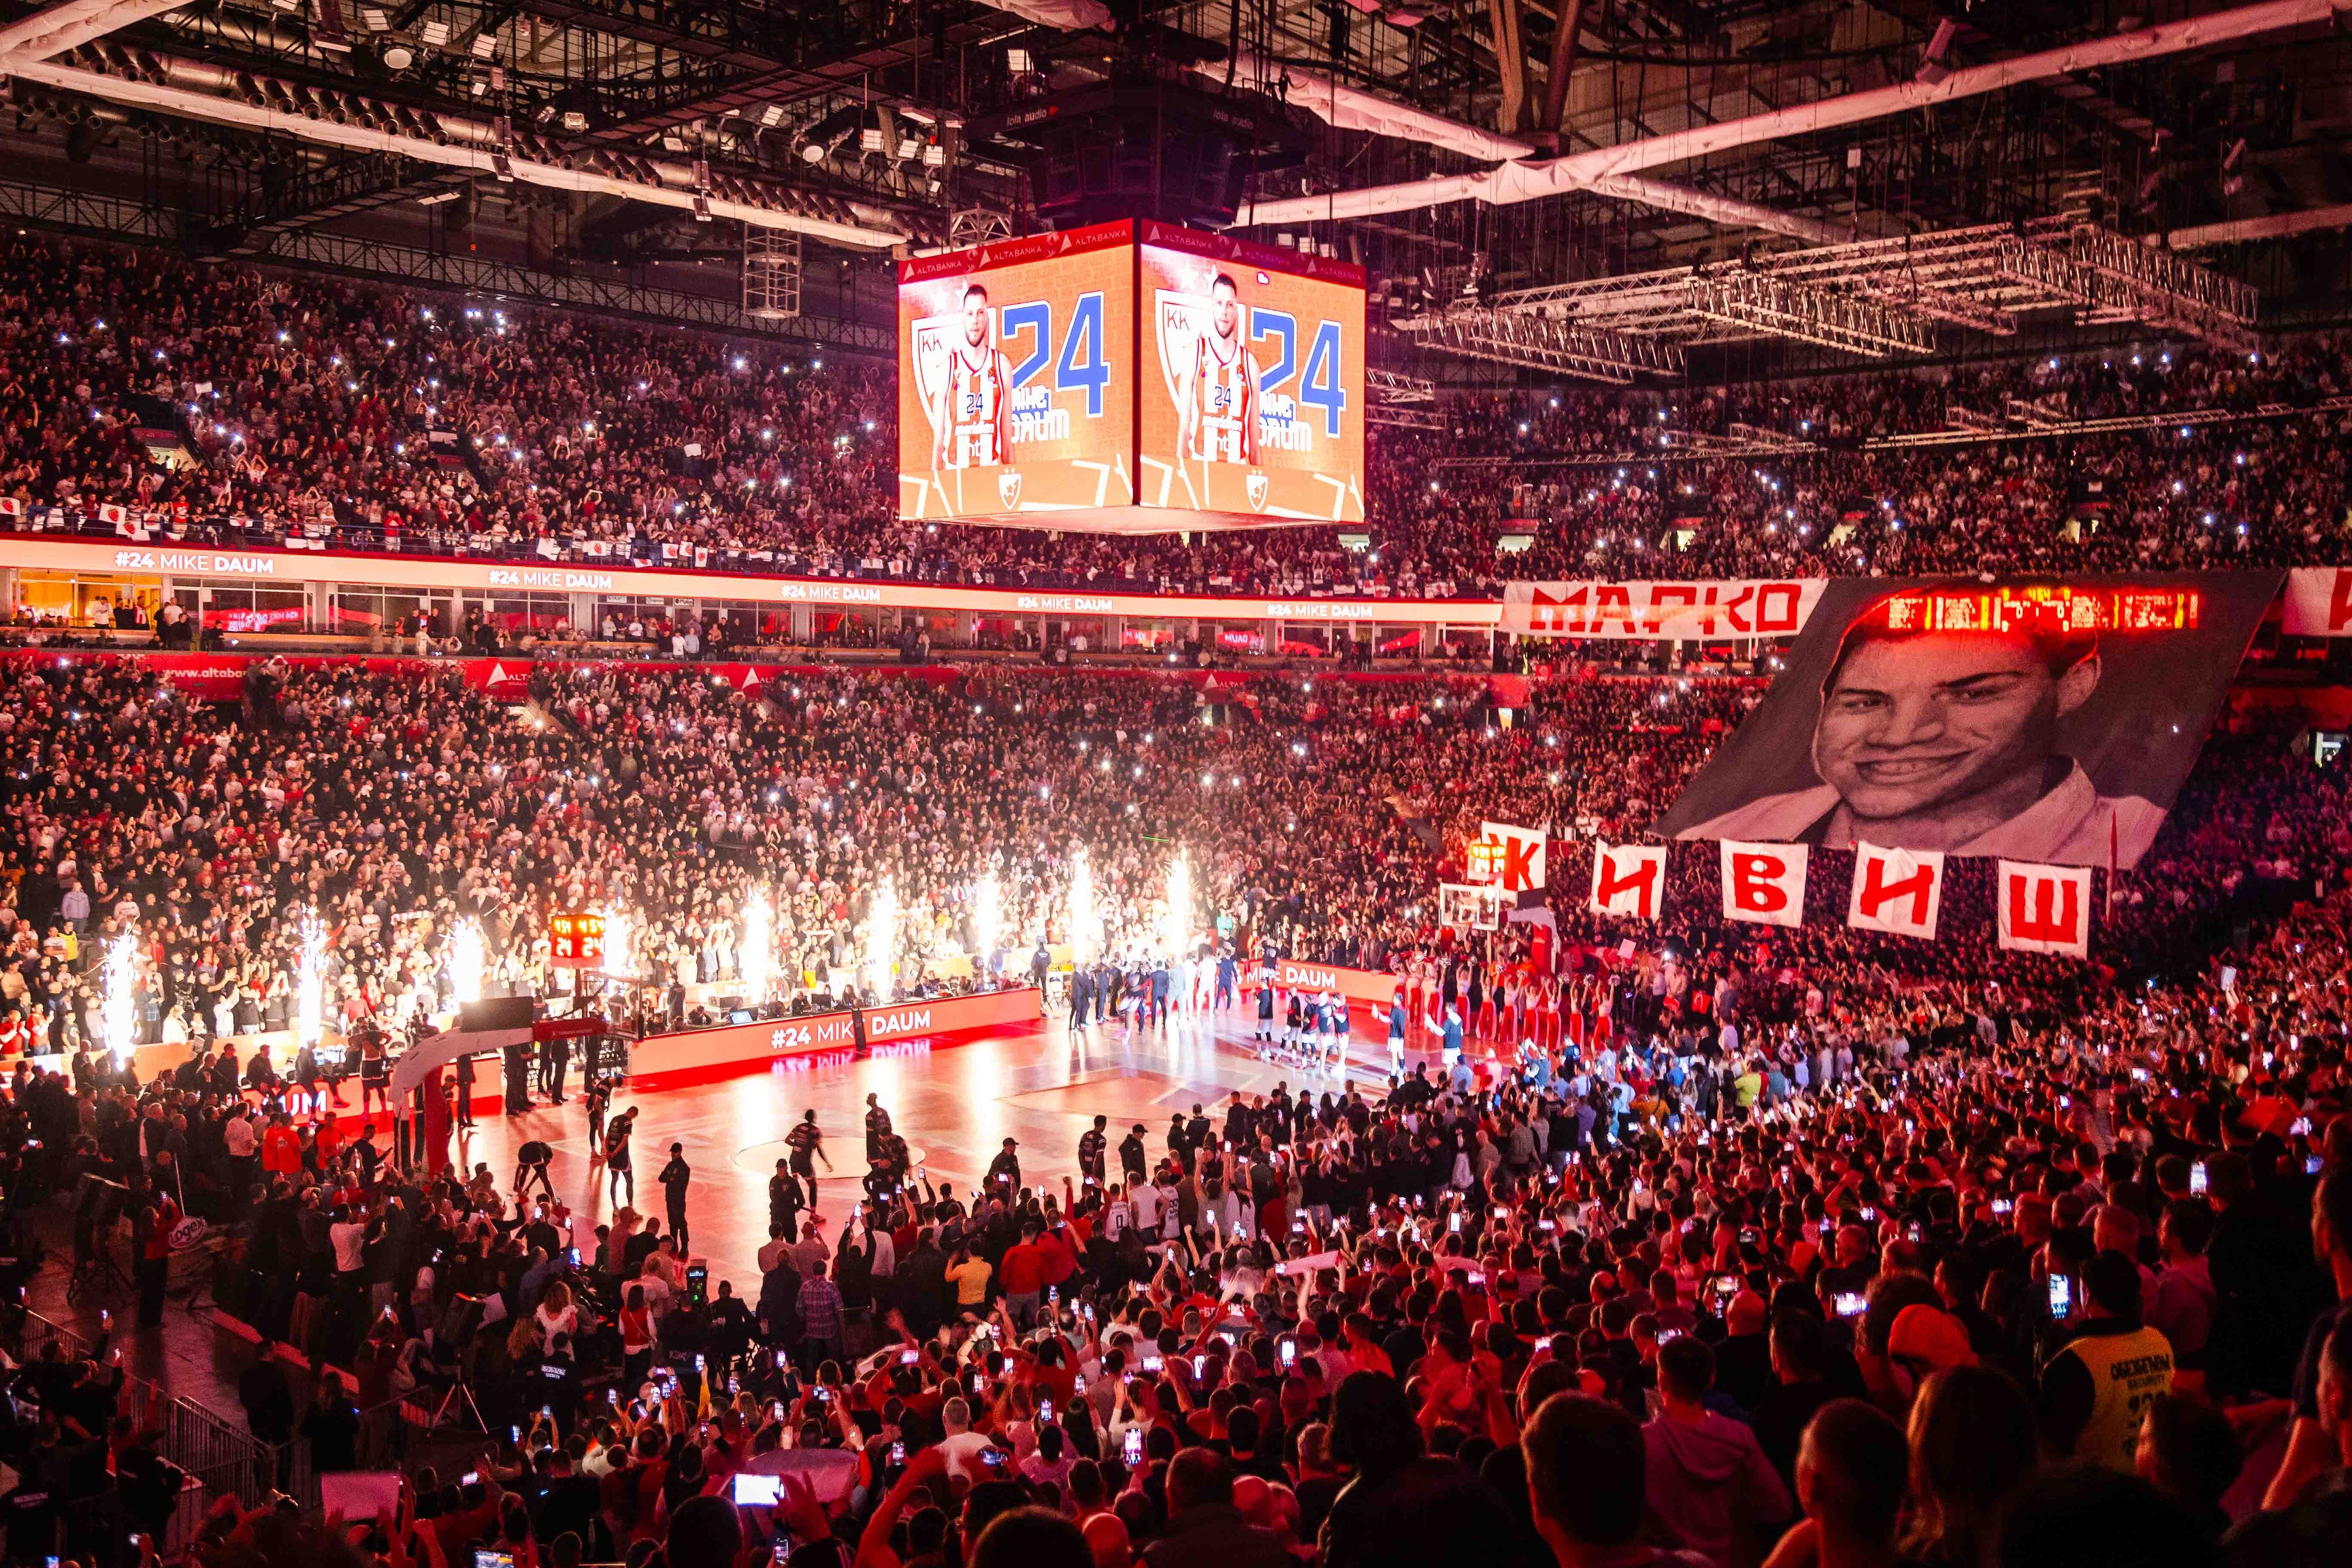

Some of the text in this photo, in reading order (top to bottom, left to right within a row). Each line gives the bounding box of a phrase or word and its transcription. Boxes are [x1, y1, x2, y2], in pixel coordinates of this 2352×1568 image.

[1024, 108, 1047, 123] audio
[1075, 229, 1128, 246] ALTABANKA
[1164, 233, 1213, 250] ALTABANKA
[994, 245, 1042, 261] ALTABANKA
[917, 261, 962, 274] ALTABANKA
[1167, 308, 1189, 331] KK
[921, 333, 942, 353] KK
[1001, 290, 1111, 419] 24
[1250, 305, 1347, 440] 24
[966, 393, 983, 415] 24
[1214, 385, 1232, 407] 24
[116, 552, 273, 574] #24 MIKE DAUM
[489, 570, 612, 589] #24 MIKE DAUM
[781, 584, 880, 601] #24 MIKE DAUM
[1042, 598, 1071, 610] MIKE
[1075, 598, 1112, 612] DAUM
[1296, 604, 1328, 617] MIKE
[1331, 605, 1373, 617] DAUM
[1529, 583, 1802, 636] МАРКО
[582, 937, 604, 957] 24
[1247, 966, 1281, 984] MIE
[1286, 966, 1336, 989] DAUM
[770, 1009, 930, 1049] #24 MIK DAUM
